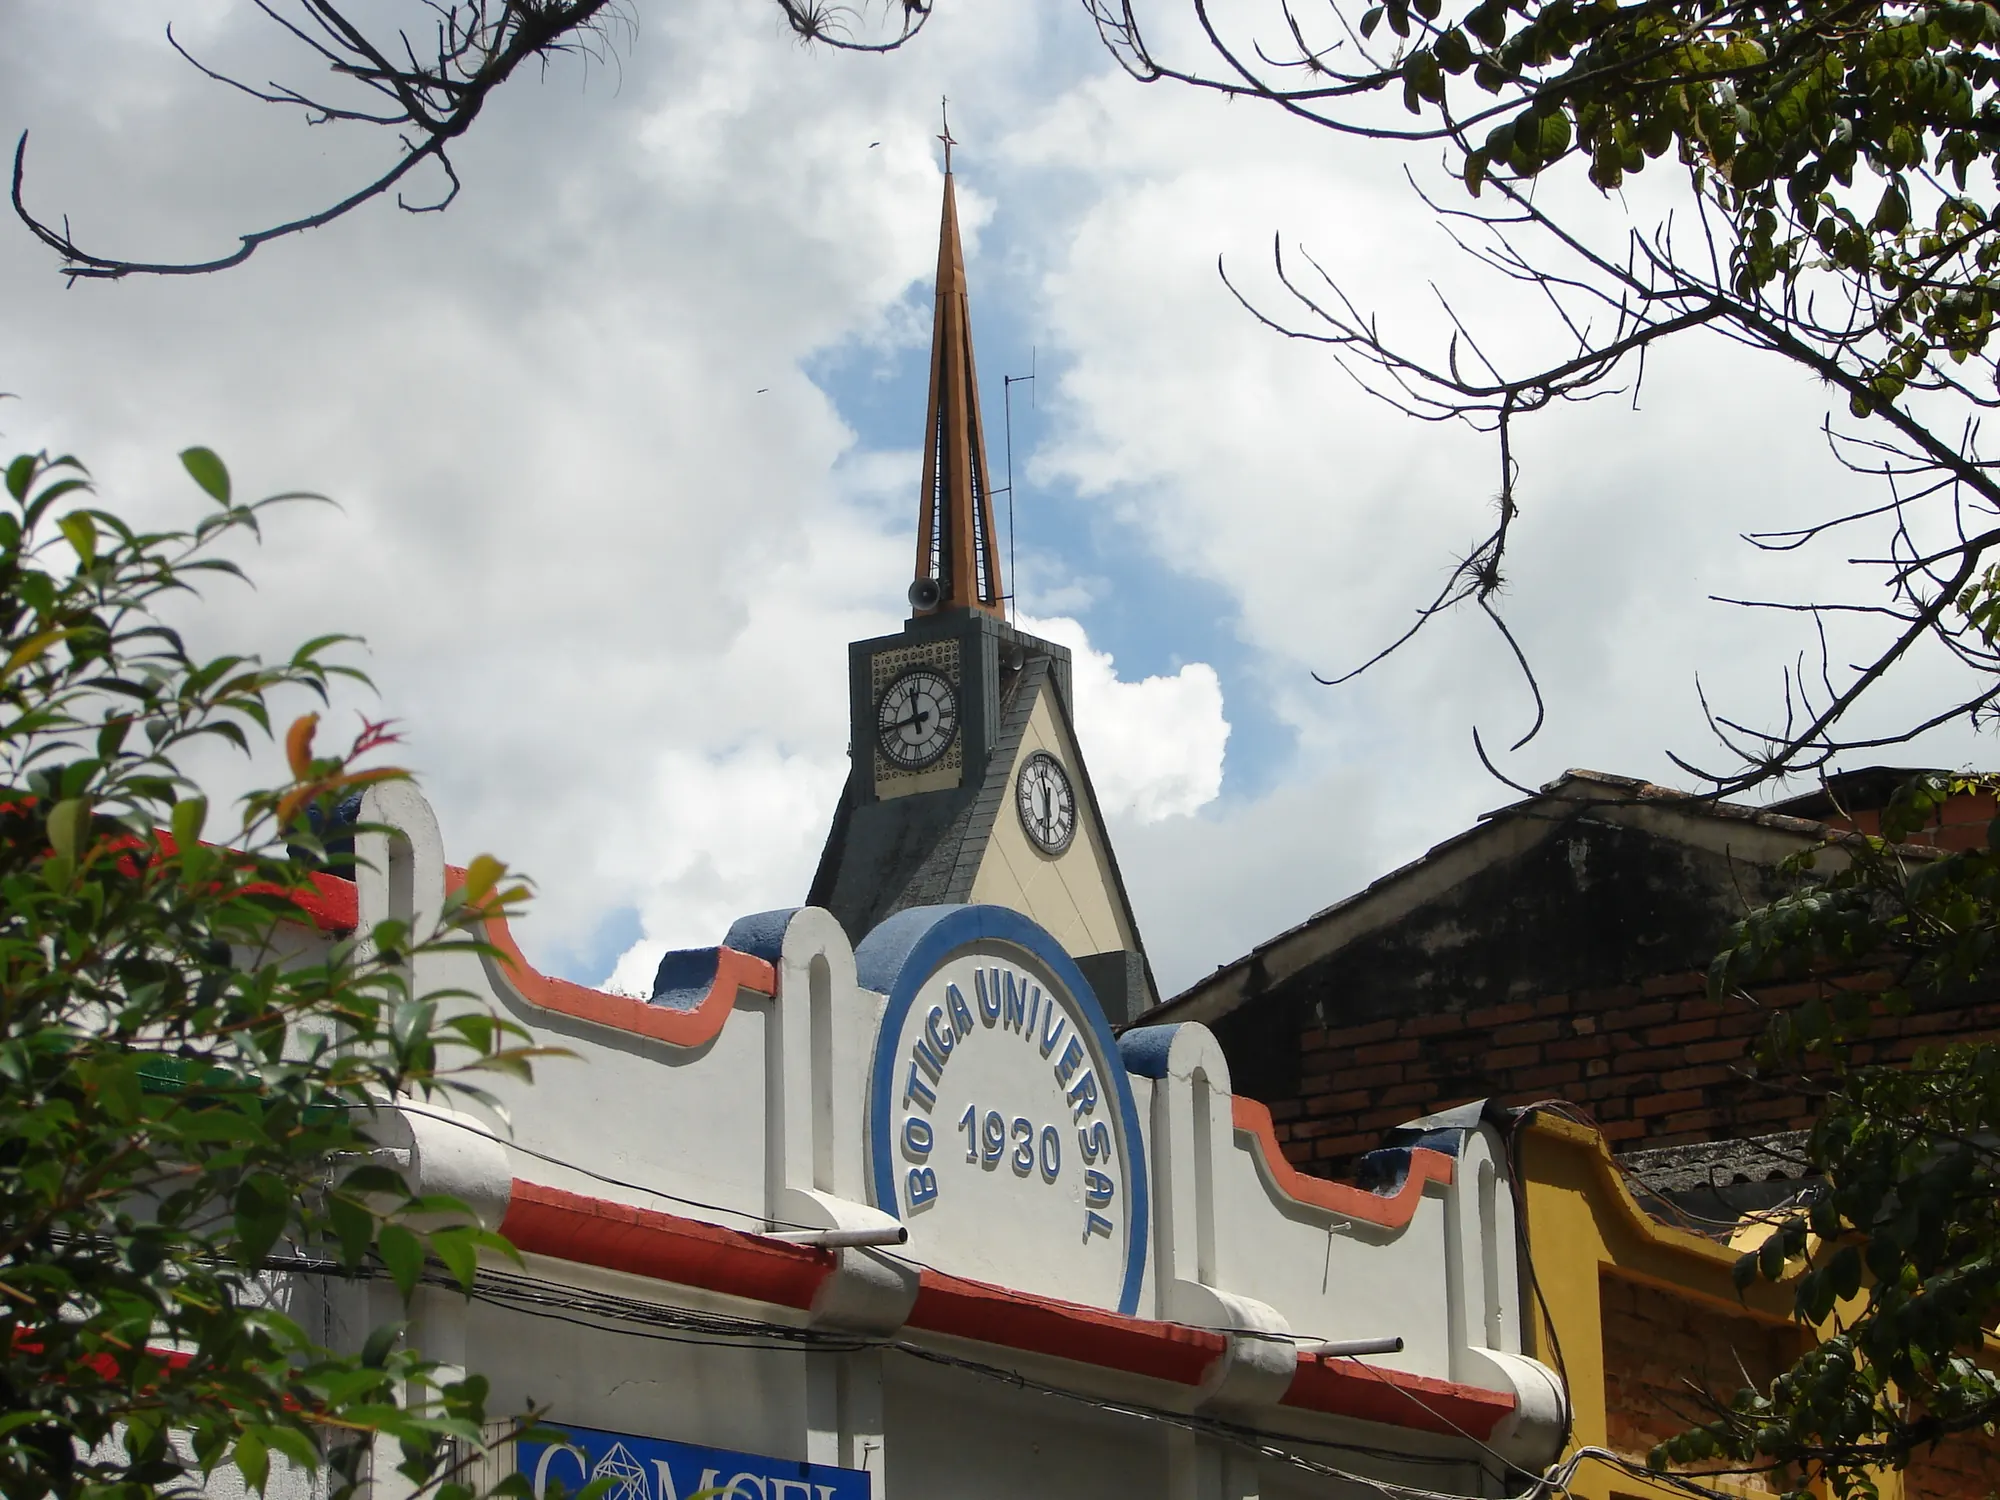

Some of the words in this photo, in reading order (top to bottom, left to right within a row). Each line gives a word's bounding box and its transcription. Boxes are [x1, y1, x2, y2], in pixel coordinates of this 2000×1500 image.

[901, 982, 975, 1217] BOTICA
[974, 967, 1115, 1244] UNIVERSAL
[958, 1103, 1061, 1184] 1930
